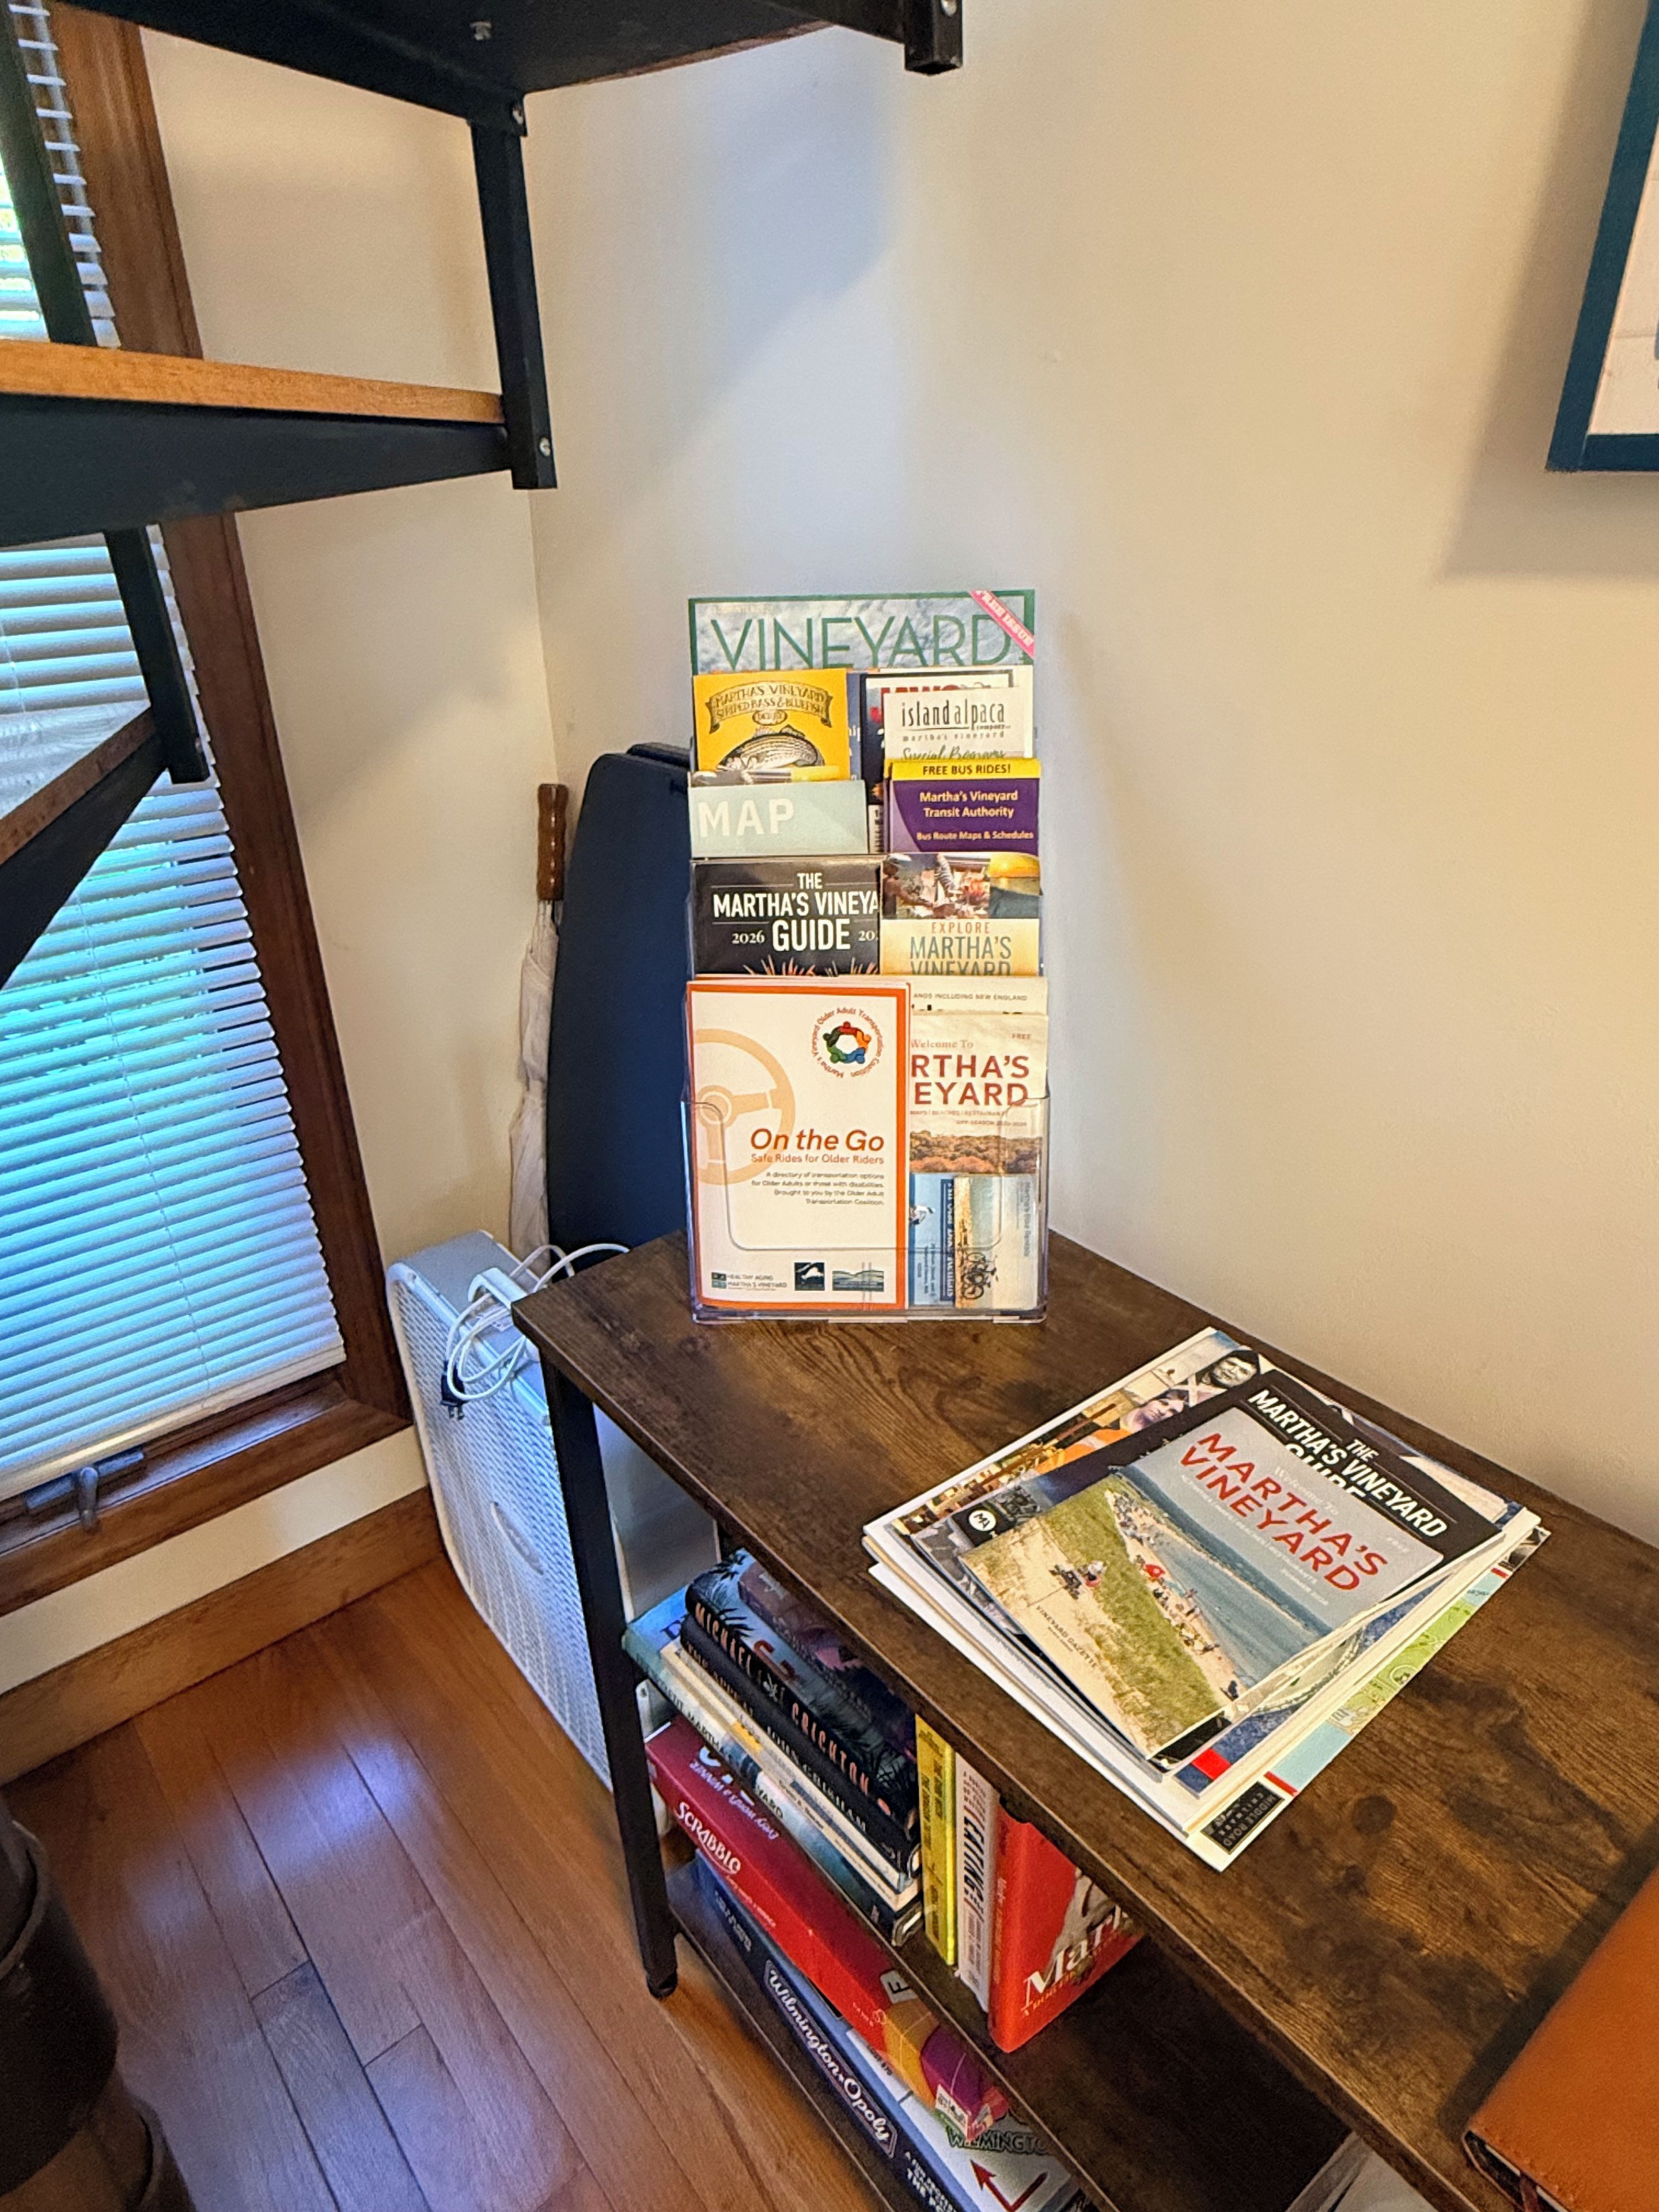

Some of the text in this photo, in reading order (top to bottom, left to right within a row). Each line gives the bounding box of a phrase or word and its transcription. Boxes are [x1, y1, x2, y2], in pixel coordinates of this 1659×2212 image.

[1002, 613, 1035, 647] ISSUE
[711, 615, 1012, 671] VINEYARD
[751, 698, 775, 708] BASS
[777, 697, 785, 707] &
[768, 684, 824, 702] VINEYARD
[902, 699, 1005, 730] island alpaca
[955, 731, 1005, 740] vineyard
[923, 764, 1011, 775] FREE BUS RIDES!
[919, 790, 1018, 803] Martha's Vineyard
[697, 798, 795, 839] MAP
[923, 807, 1014, 819] Transit Authority
[959, 832, 982, 840] Maps
[992, 831, 1033, 839] Schedules
[797, 872, 823, 889] THE
[713, 891, 878, 918] MARTHA'S VINEYA
[732, 919, 878, 950] 2026 GUIDE 20
[931, 922, 990, 934] EXPLORE
[910, 936, 1012, 959] MARTHA'S
[911, 1039, 974, 1049] Welcome To
[911, 1055, 1029, 1078] RTHA'S
[915, 1082, 1028, 1106] EYARD
[751, 1128, 885, 1151] On the Go
[751, 1154, 884, 1164] Safe Rides for Older Riders
[1346, 1438, 1379, 1464] THE
[1248, 1389, 1347, 1465] MARTHA'S
[1340, 1459, 1448, 1539] VINEYARD
[1181, 1474, 1212, 1503] ACTIVITIES
[1274, 1466, 1324, 1503] Welcome
[1324, 1502, 1339, 1516] To
[1197, 1433, 1388, 1576] MARTHA'S
[1181, 1445, 1360, 1590] VINEYARD
[695, 1602, 752, 1679] MICHAEL
[791, 1702, 869, 1796] CRICHTON
[1244, 1794, 1277, 1825] MIDDLE
[677, 1801, 741, 1873] SCRABBLE
[1222, 1822, 1249, 1847] ROAD
